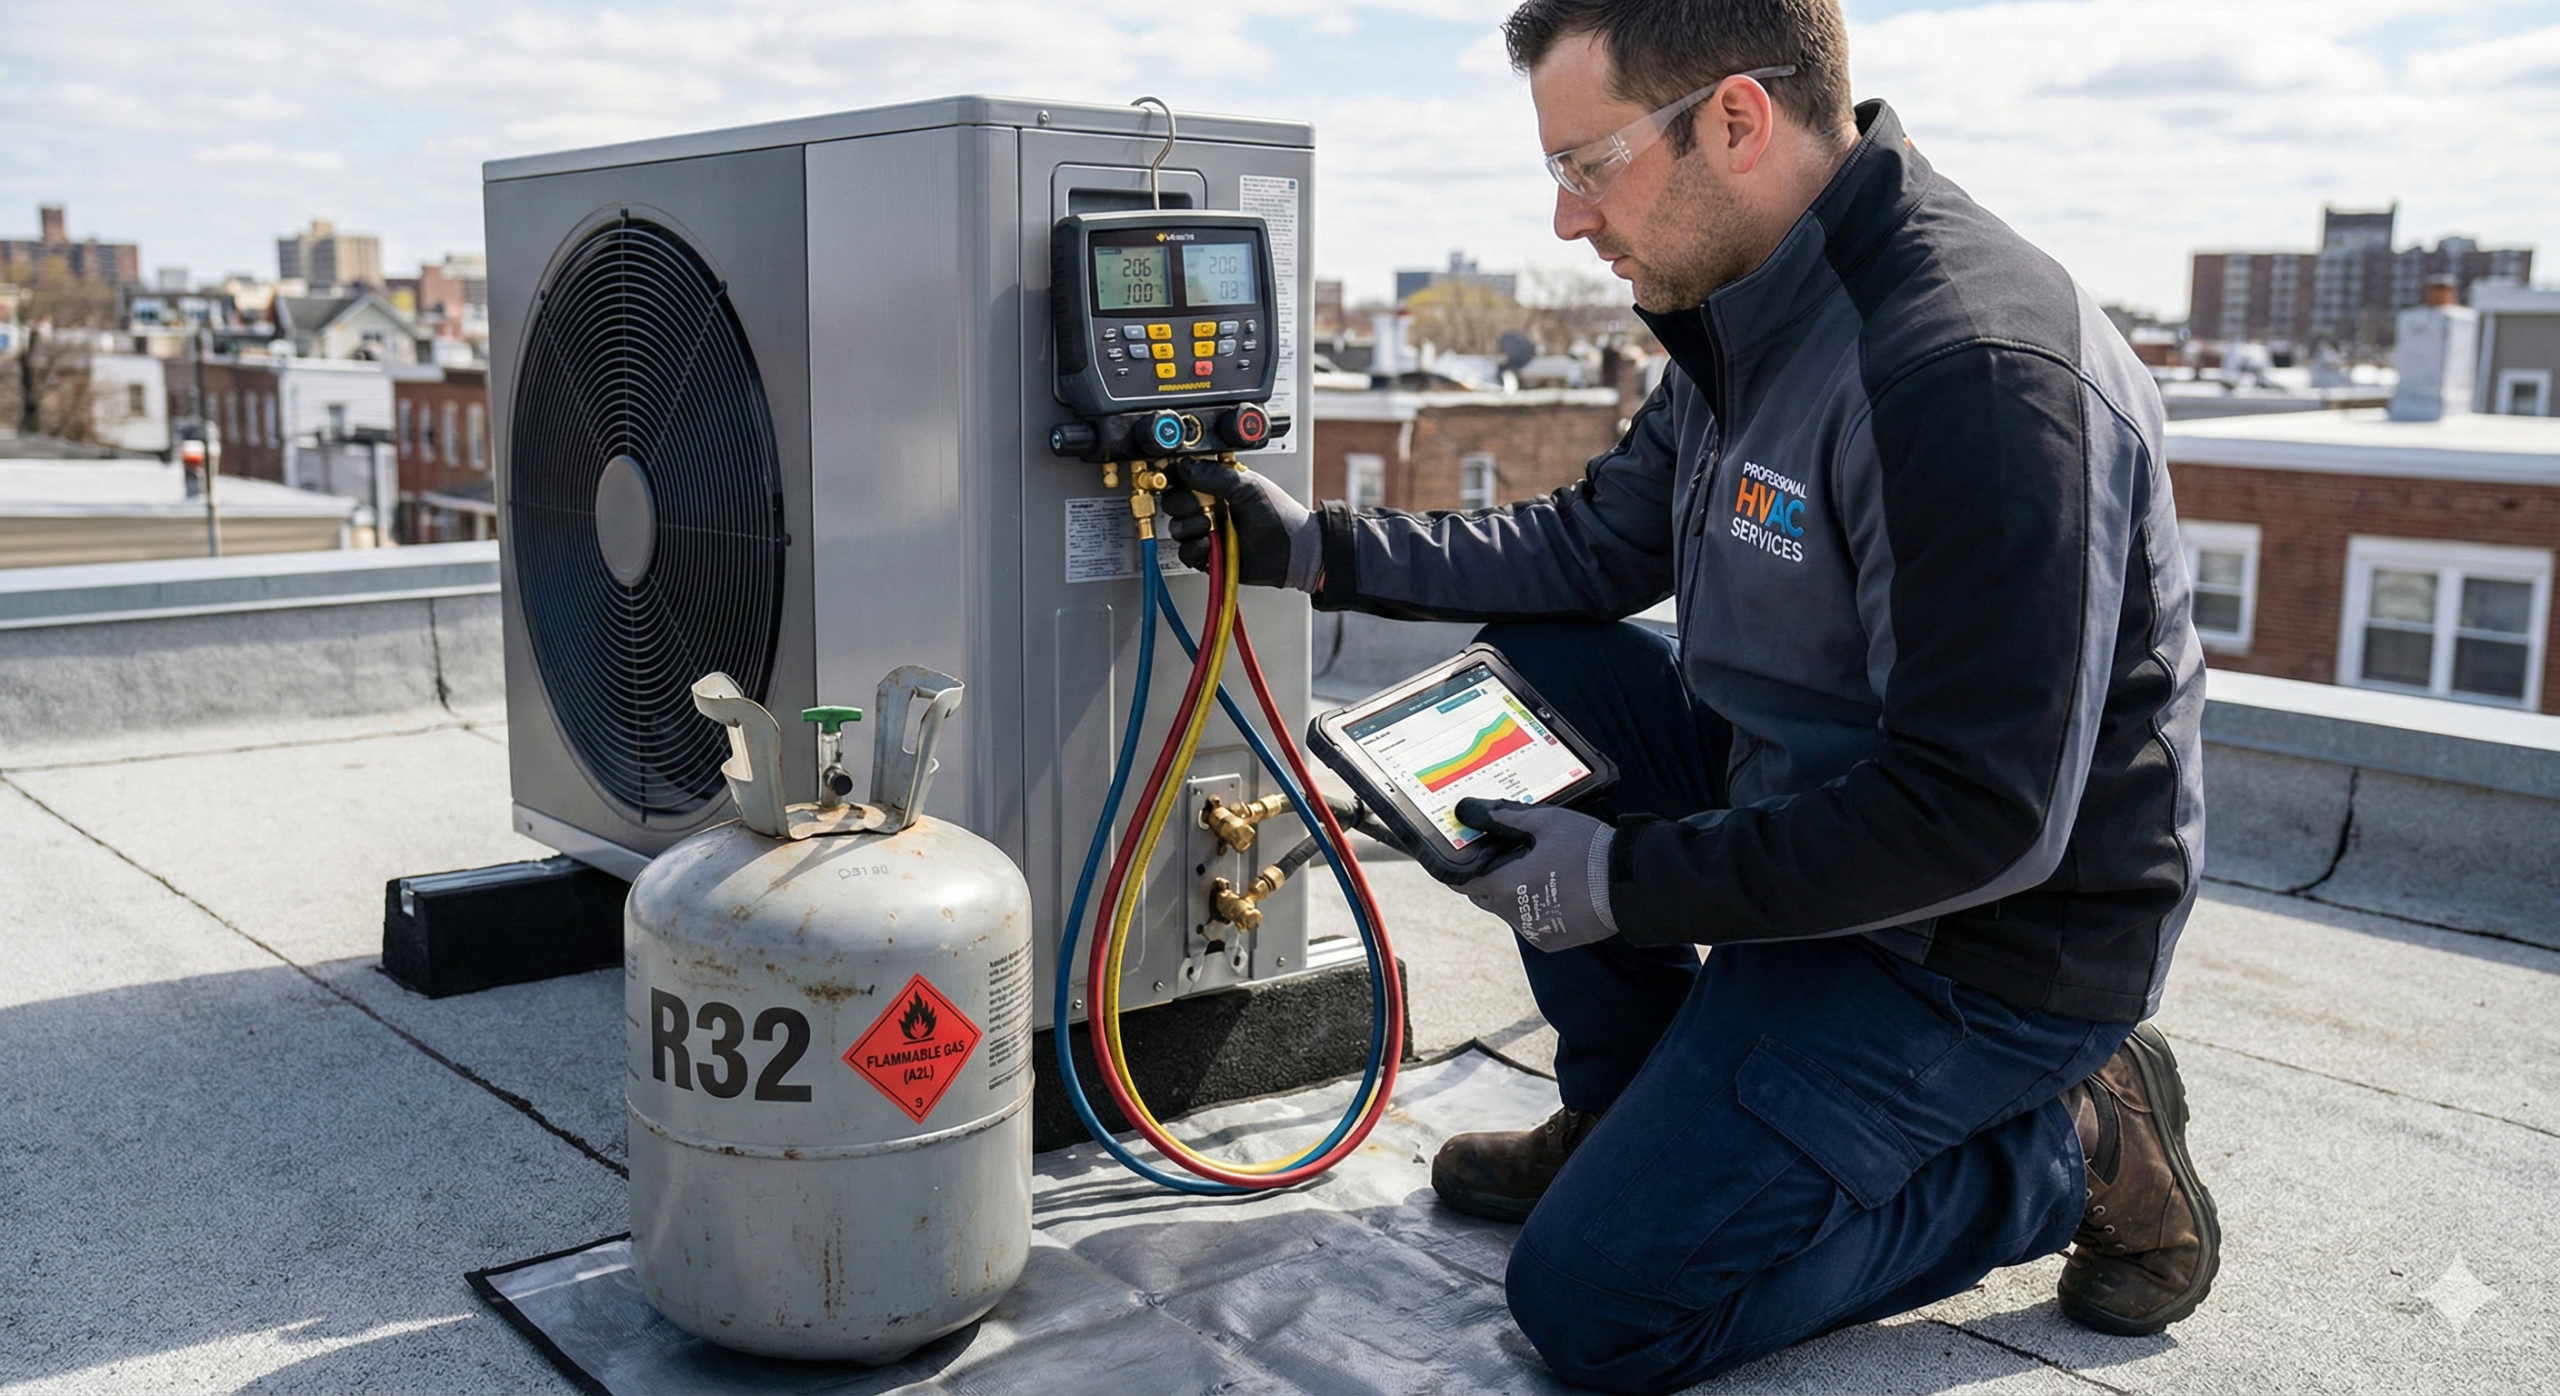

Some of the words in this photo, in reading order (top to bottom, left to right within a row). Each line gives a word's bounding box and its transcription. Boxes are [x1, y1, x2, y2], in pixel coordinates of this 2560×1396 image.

[1122, 258, 1152, 278] 206
[1209, 256, 1237, 275] 200
[1127, 283, 1154, 304] 100
[1742, 461, 1807, 499] PROFESSIONAL
[1735, 477, 1806, 538] HVAC
[1730, 517, 1804, 563] SERVICES
[650, 986, 812, 1103] R32
[866, 1045, 941, 1069] FLAMMABLE
[943, 1039, 965, 1057] GAS
[903, 1064, 935, 1086] (A2L)
[914, 1096, 924, 1108] 3
